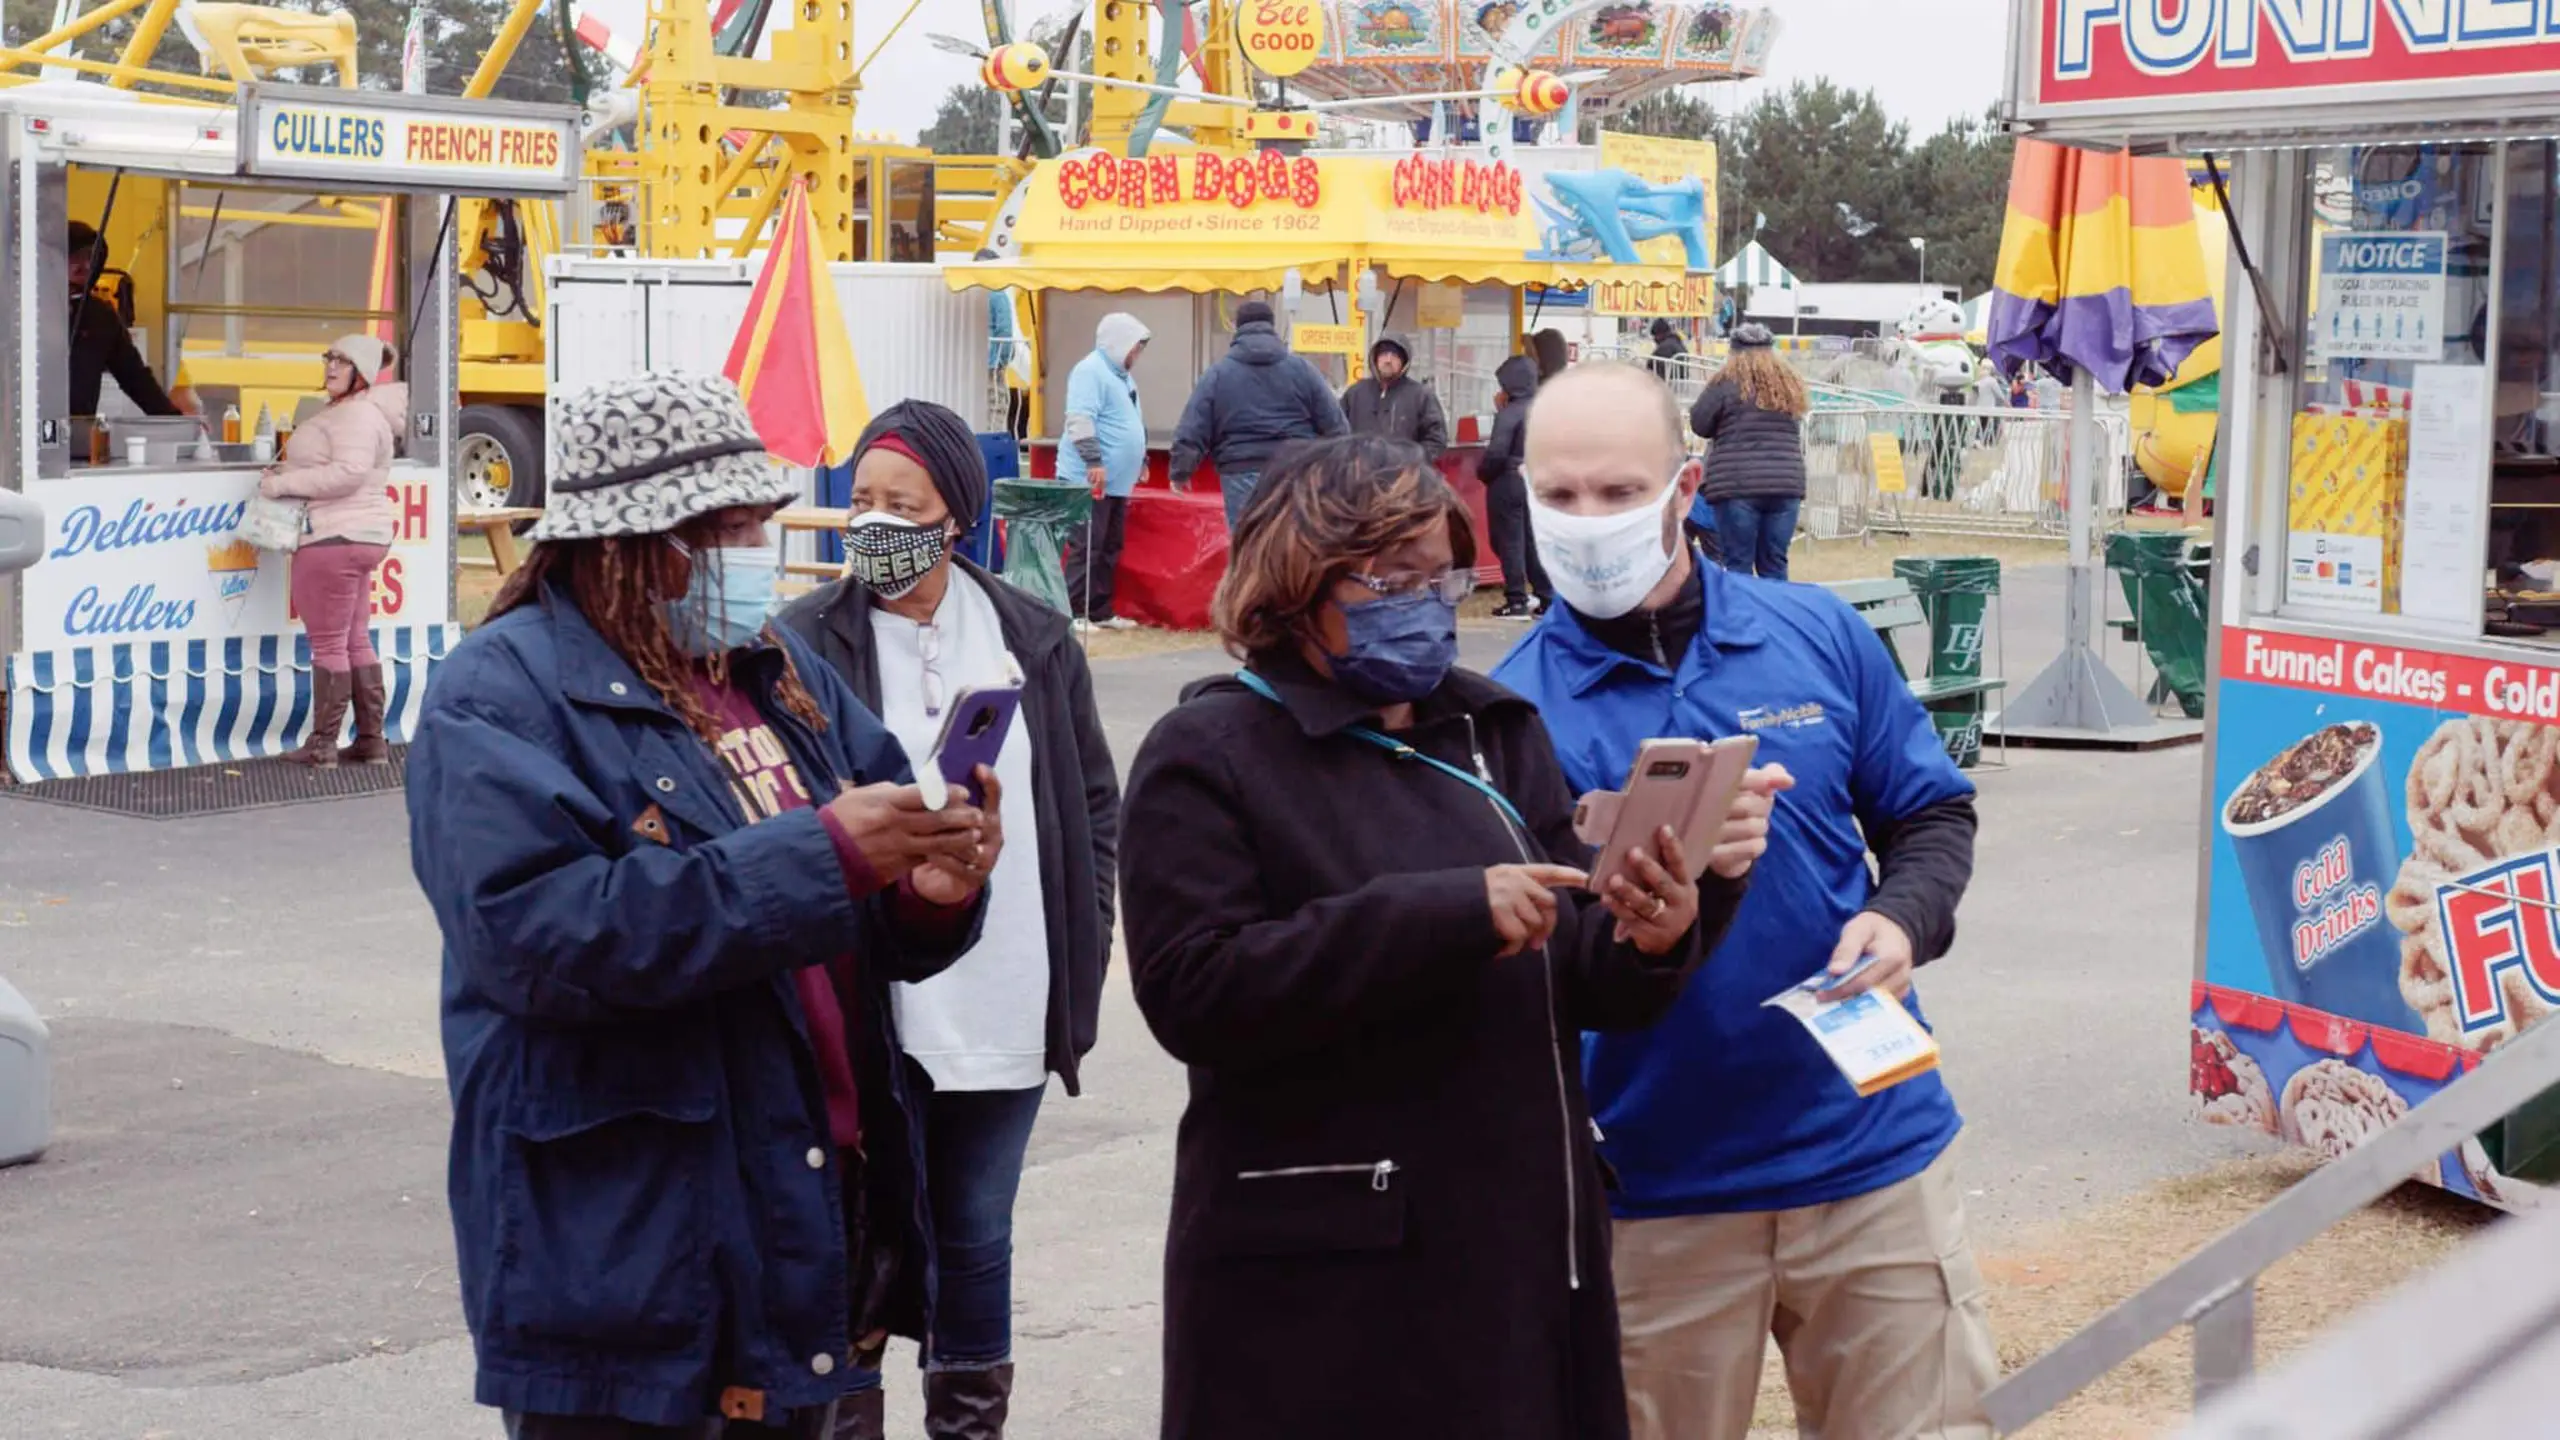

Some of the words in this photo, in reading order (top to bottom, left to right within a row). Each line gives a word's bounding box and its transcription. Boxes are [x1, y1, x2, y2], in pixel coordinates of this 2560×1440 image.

[1251, 33, 1315, 51] GOOD
[2055, 0, 2560, 78] FUNN
[273, 111, 385, 157] CULLERS
[406, 123, 492, 163] FRENCH
[499, 128, 559, 167] FRIES
[1058, 150, 1181, 210] CORN
[1192, 148, 1321, 209] DOGS
[1393, 151, 1456, 211] CORN
[1460, 157, 1522, 217] DOGS
[1059, 214, 1112, 231] Hand
[1119, 214, 1192, 235] Dipped
[1273, 214, 1321, 231] 1962
[2338, 242, 2429, 269] NOTICE
[2387, 296, 2420, 308] PLACE
[50, 497, 246, 560] Delicious
[849, 544, 934, 585] UEEN
[64, 583, 197, 637] Cullers
[2246, 634, 2344, 687] Funnel
[2353, 649, 2447, 702] Cakes
[2484, 665, 2560, 718] Cold
[2294, 838, 2350, 908] Cold
[2294, 887, 2379, 966] Drinks
